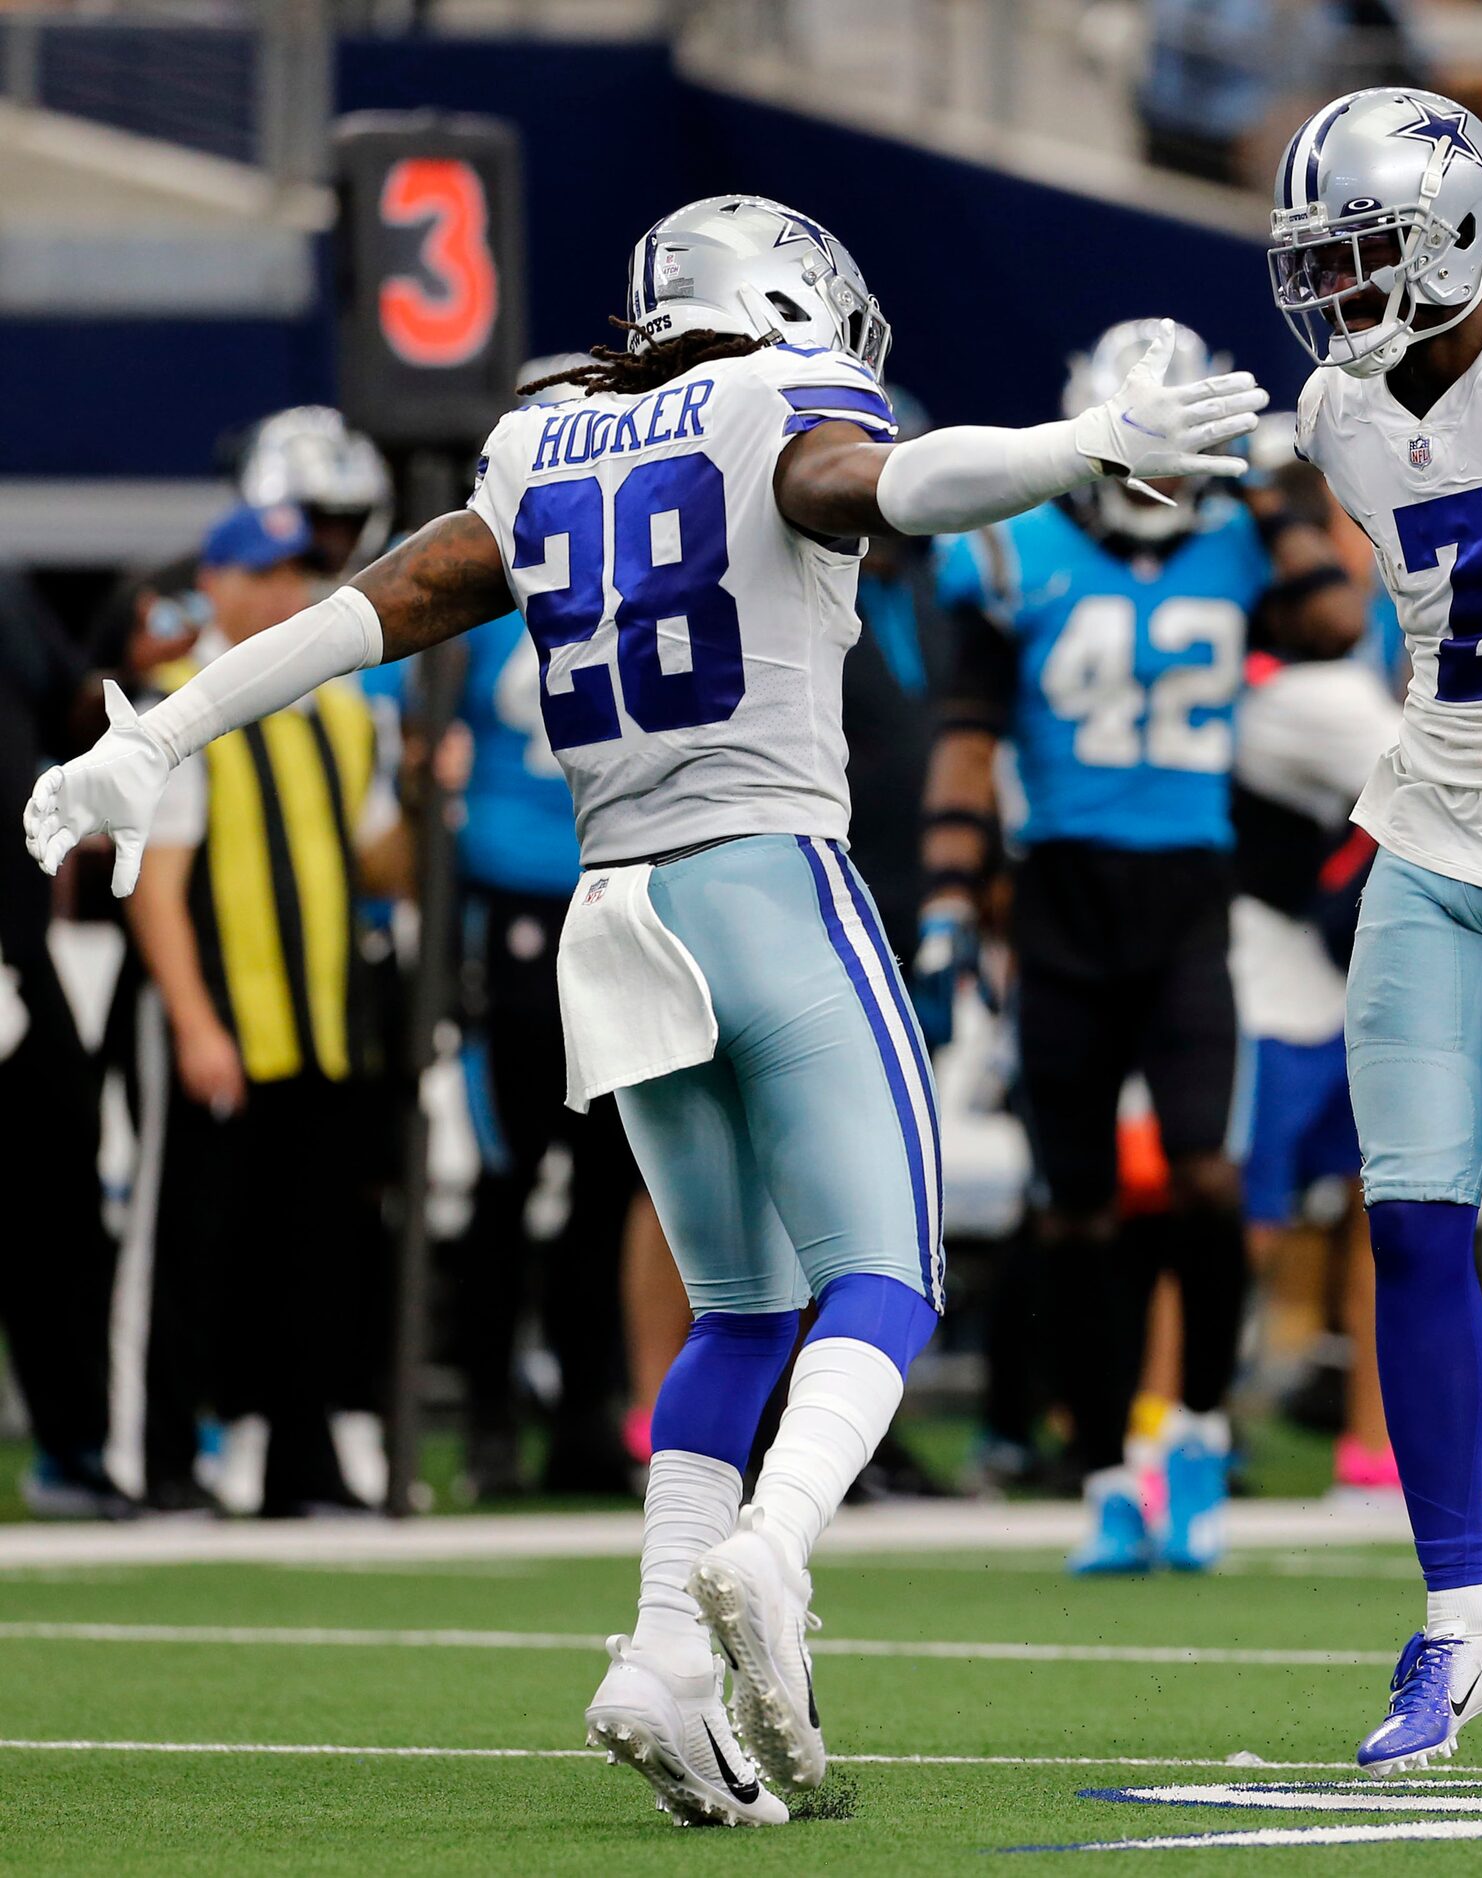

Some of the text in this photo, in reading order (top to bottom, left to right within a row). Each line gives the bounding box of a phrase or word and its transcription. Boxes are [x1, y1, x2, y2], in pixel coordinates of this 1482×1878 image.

[379, 157, 498, 369] 3
[532, 379, 714, 471] HOOKER
[511, 451, 746, 751] 28
[1041, 594, 1249, 773] 42
